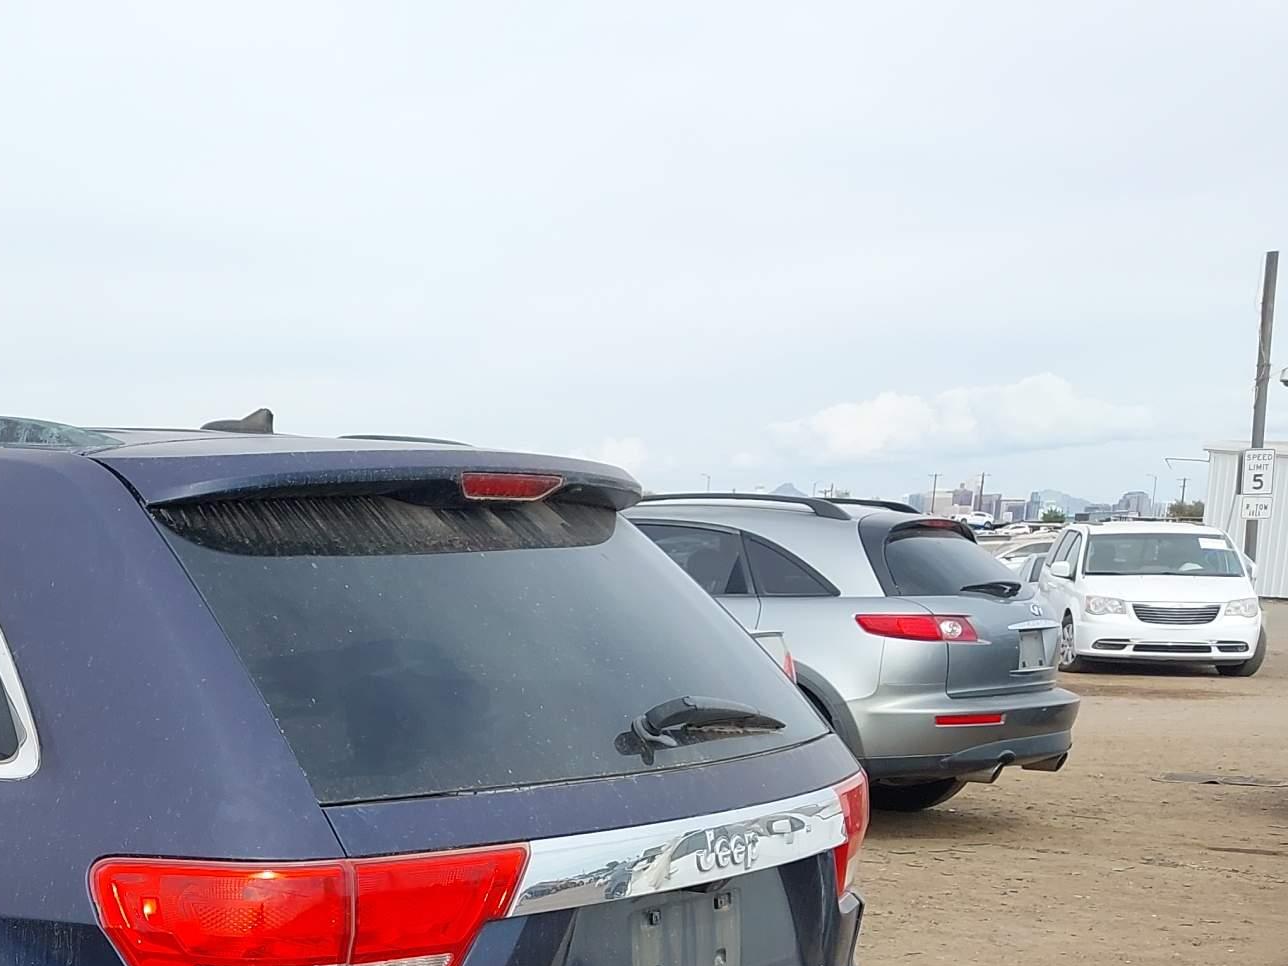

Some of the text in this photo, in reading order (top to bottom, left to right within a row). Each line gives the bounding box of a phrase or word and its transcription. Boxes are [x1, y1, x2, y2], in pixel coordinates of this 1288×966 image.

[1246, 453, 1273, 461] SPEED
[1248, 463, 1269, 471] LIMIT
[1252, 473, 1265, 490] 5
[696, 829, 759, 873] Jeep
